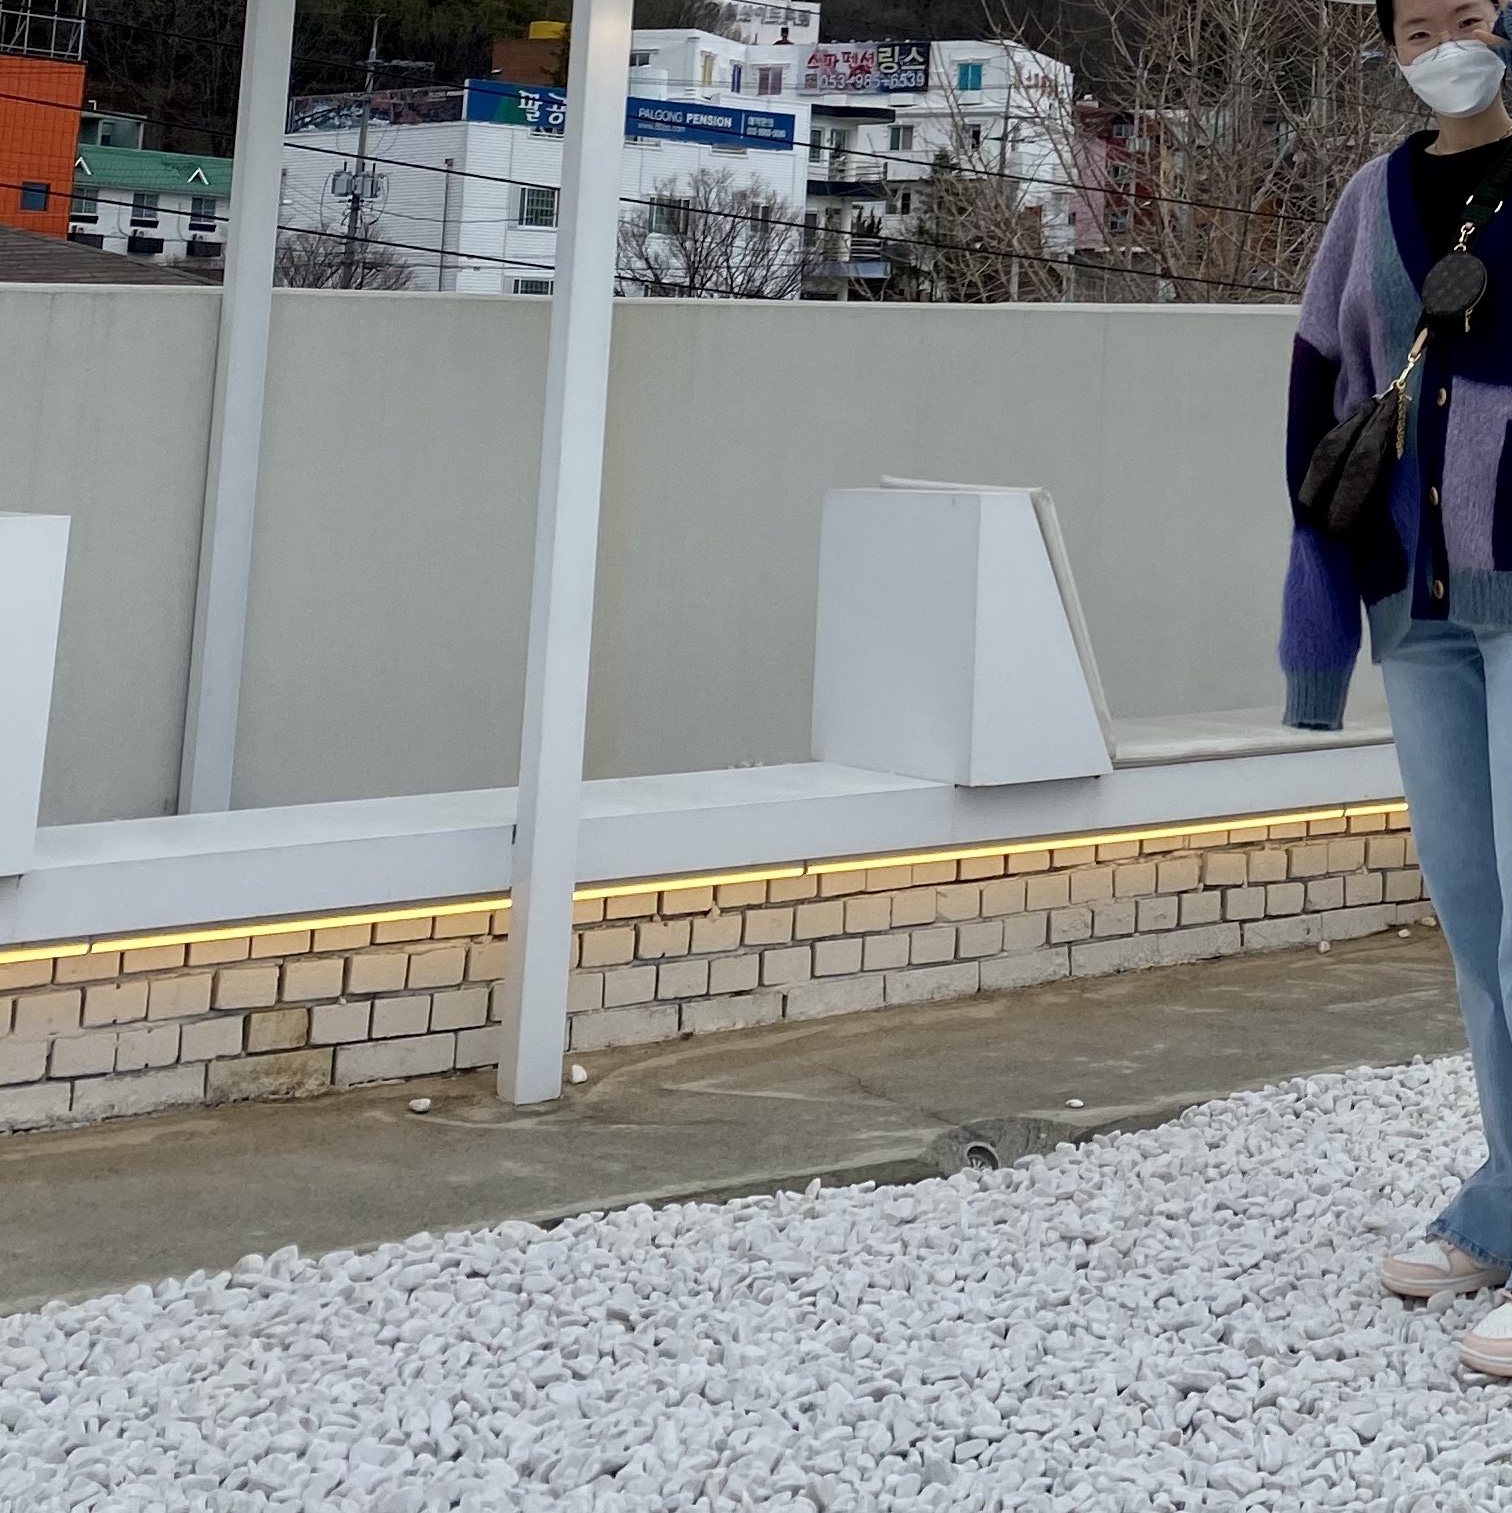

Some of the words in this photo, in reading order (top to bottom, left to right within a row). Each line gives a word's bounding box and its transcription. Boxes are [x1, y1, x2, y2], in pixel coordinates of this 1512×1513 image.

[878, 46, 926, 74] 링스
[820, 71, 925, 89] 053-985-6539
[638, 108, 683, 123] PALGONG
[686, 113, 732, 128] PENSION
